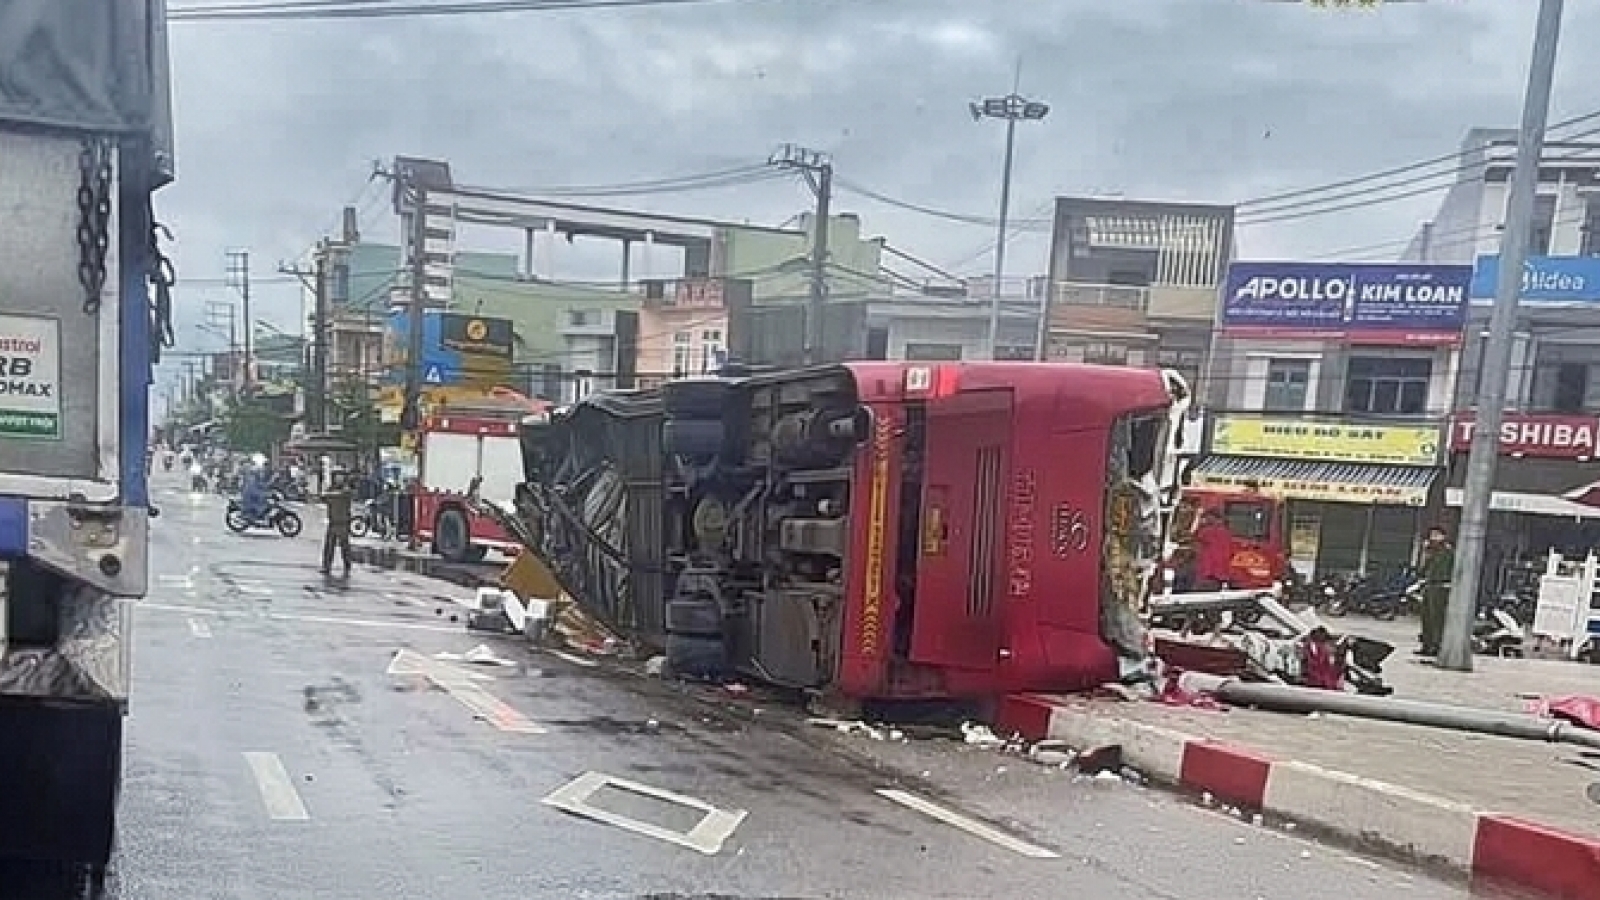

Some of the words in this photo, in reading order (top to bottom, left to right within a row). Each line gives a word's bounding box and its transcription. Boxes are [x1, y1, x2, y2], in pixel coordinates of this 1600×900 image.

[1236, 276, 1345, 300] APOLLO
[1361, 284, 1401, 302] KIM
[1405, 285, 1463, 303] LOAN
[1458, 421, 1593, 447] TSHIBA
